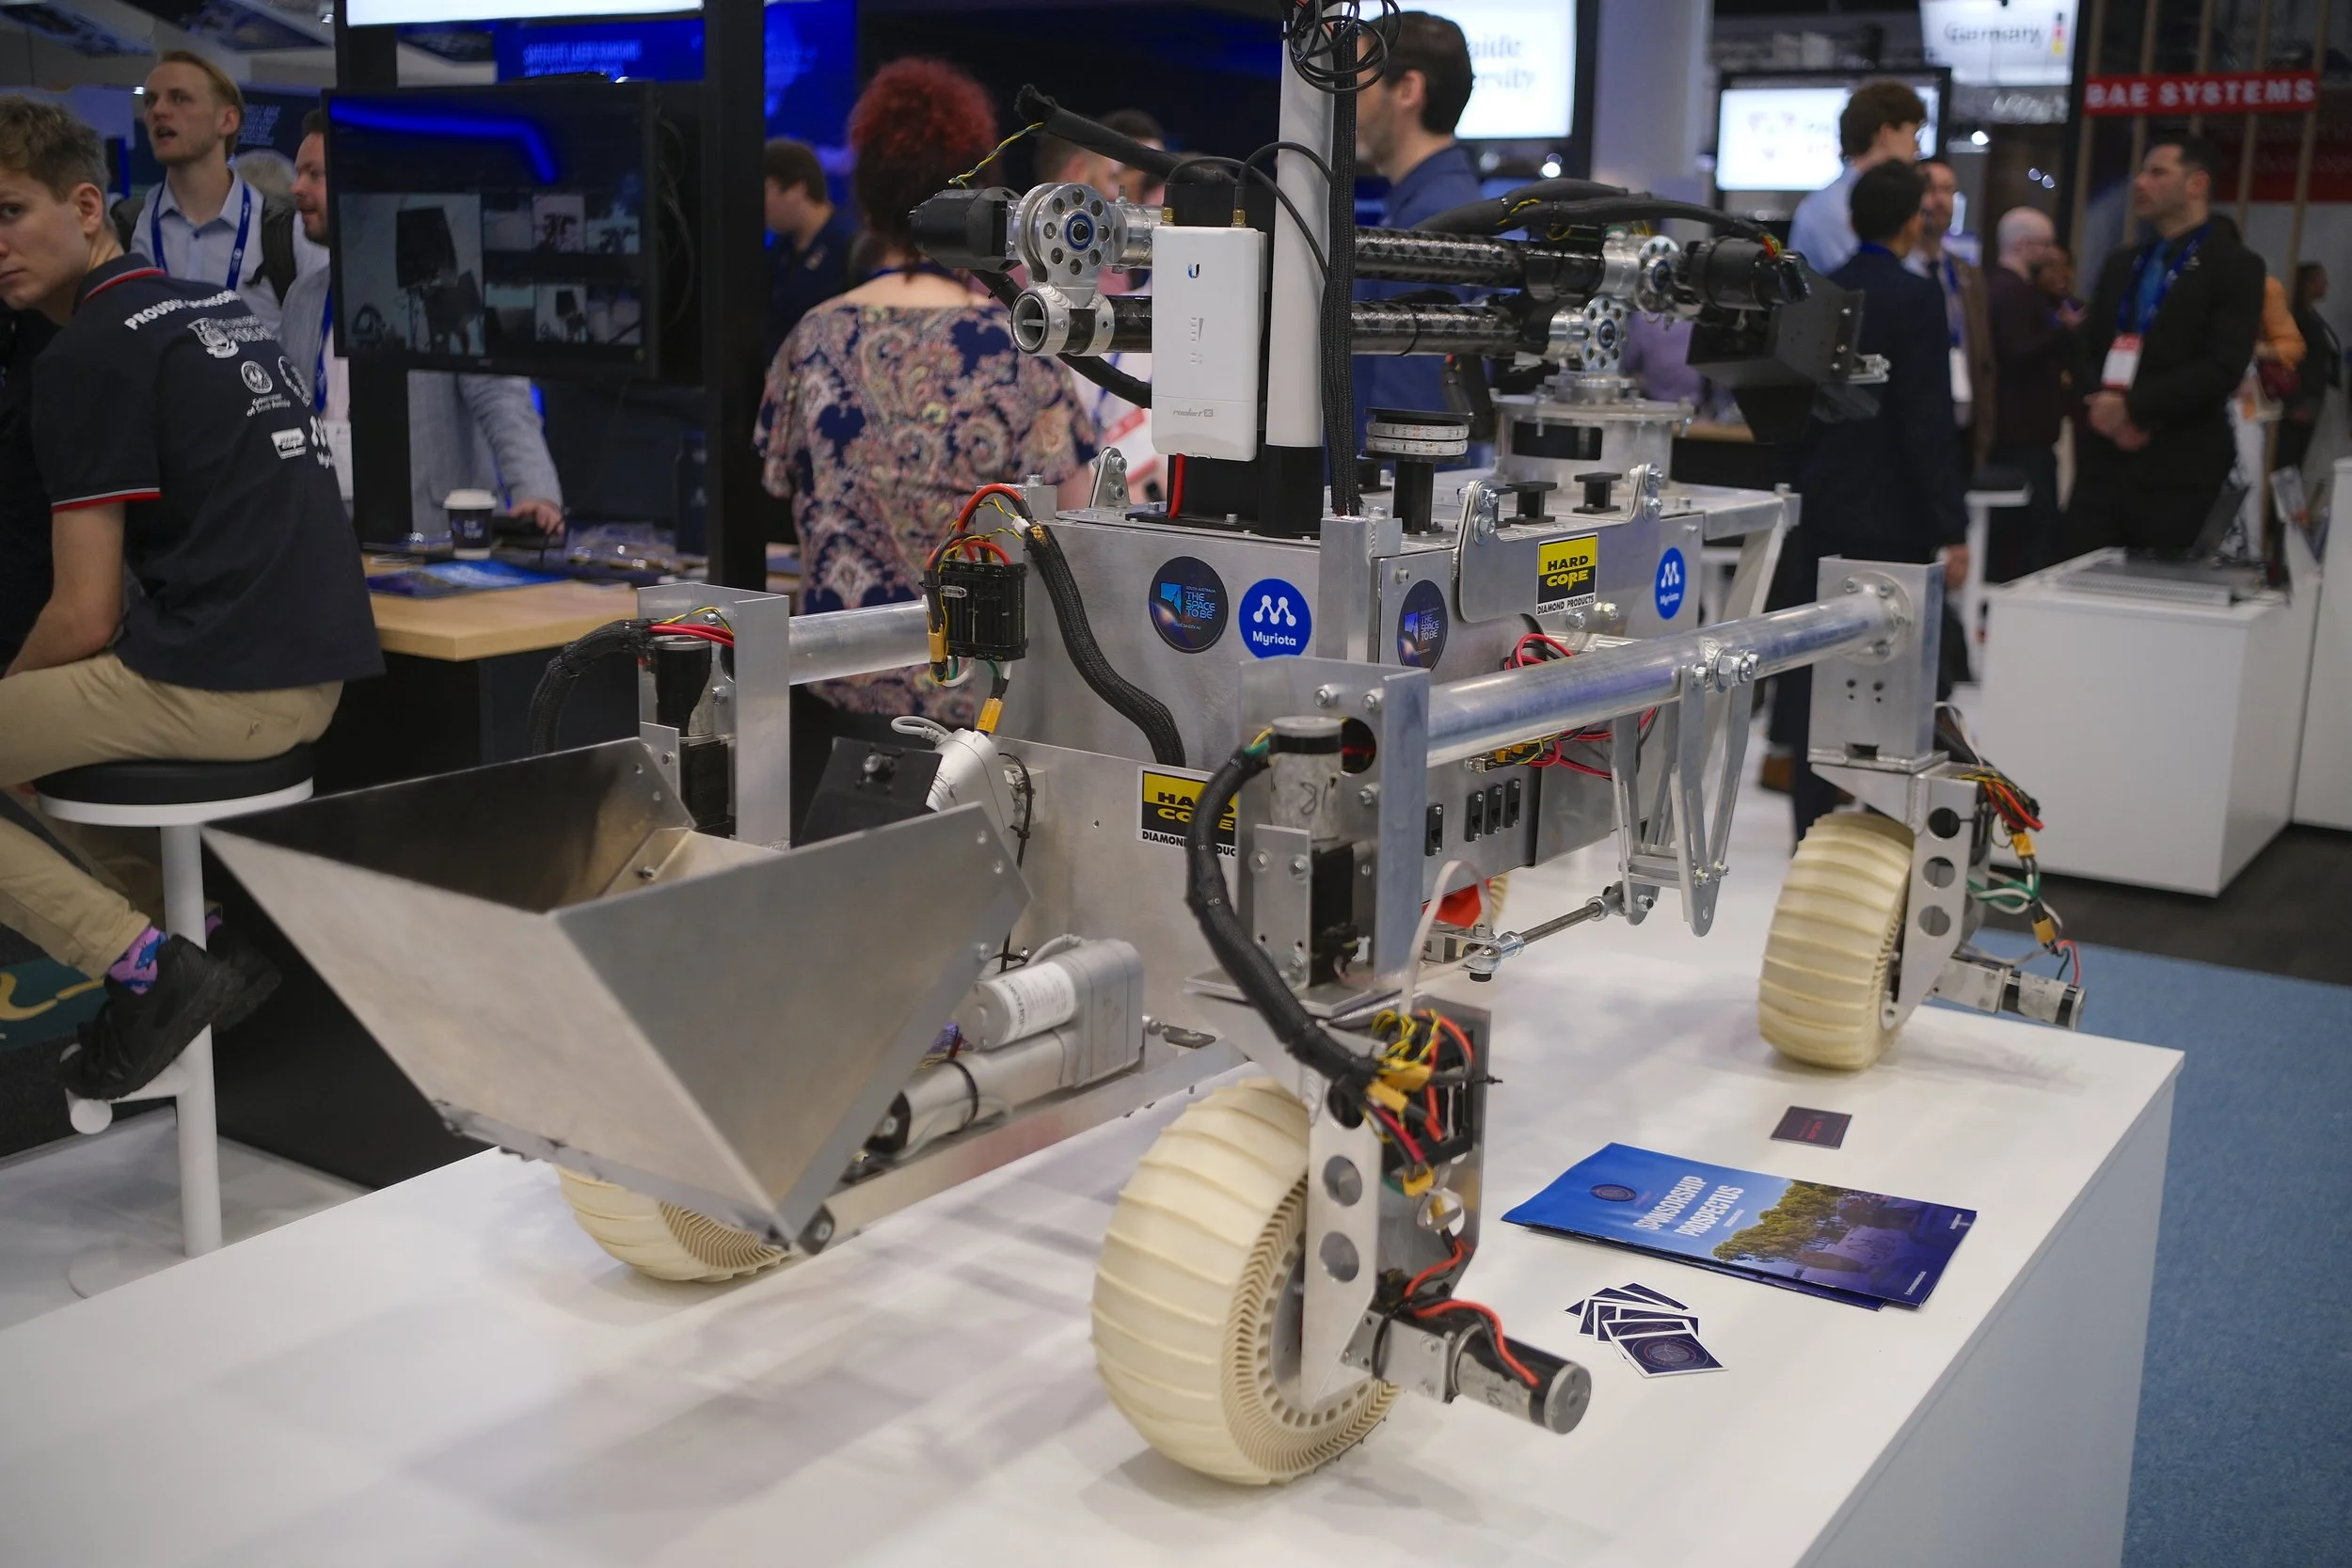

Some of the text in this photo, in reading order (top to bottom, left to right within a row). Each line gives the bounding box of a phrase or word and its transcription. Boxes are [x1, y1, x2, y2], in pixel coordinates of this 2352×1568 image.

[1945, 23, 2042, 47] Germany
[2085, 78, 2315, 108] BAE SYSTEMS
[1548, 555, 1589, 572] HARD
[1547, 570, 1588, 591] CORE
[1185, 591, 1204, 600] THE
[1660, 592, 1679, 606] Myriota
[1185, 600, 1216, 611] SPACE
[1537, 594, 1594, 614] DIAMOND PRODUCTS
[1200, 611, 1213, 620] BE
[1421, 614, 1433, 625] THE
[1421, 620, 1439, 633] SPACE
[1252, 630, 1296, 646] Myriota
[1422, 629, 1438, 641] TO BE
[1157, 808, 1234, 832] COE
[1142, 831, 1187, 847] DIAMON
[1633, 1176, 1707, 1230] SPONSORSHIP
[1674, 1184, 1744, 1237] PROSPECTUS
